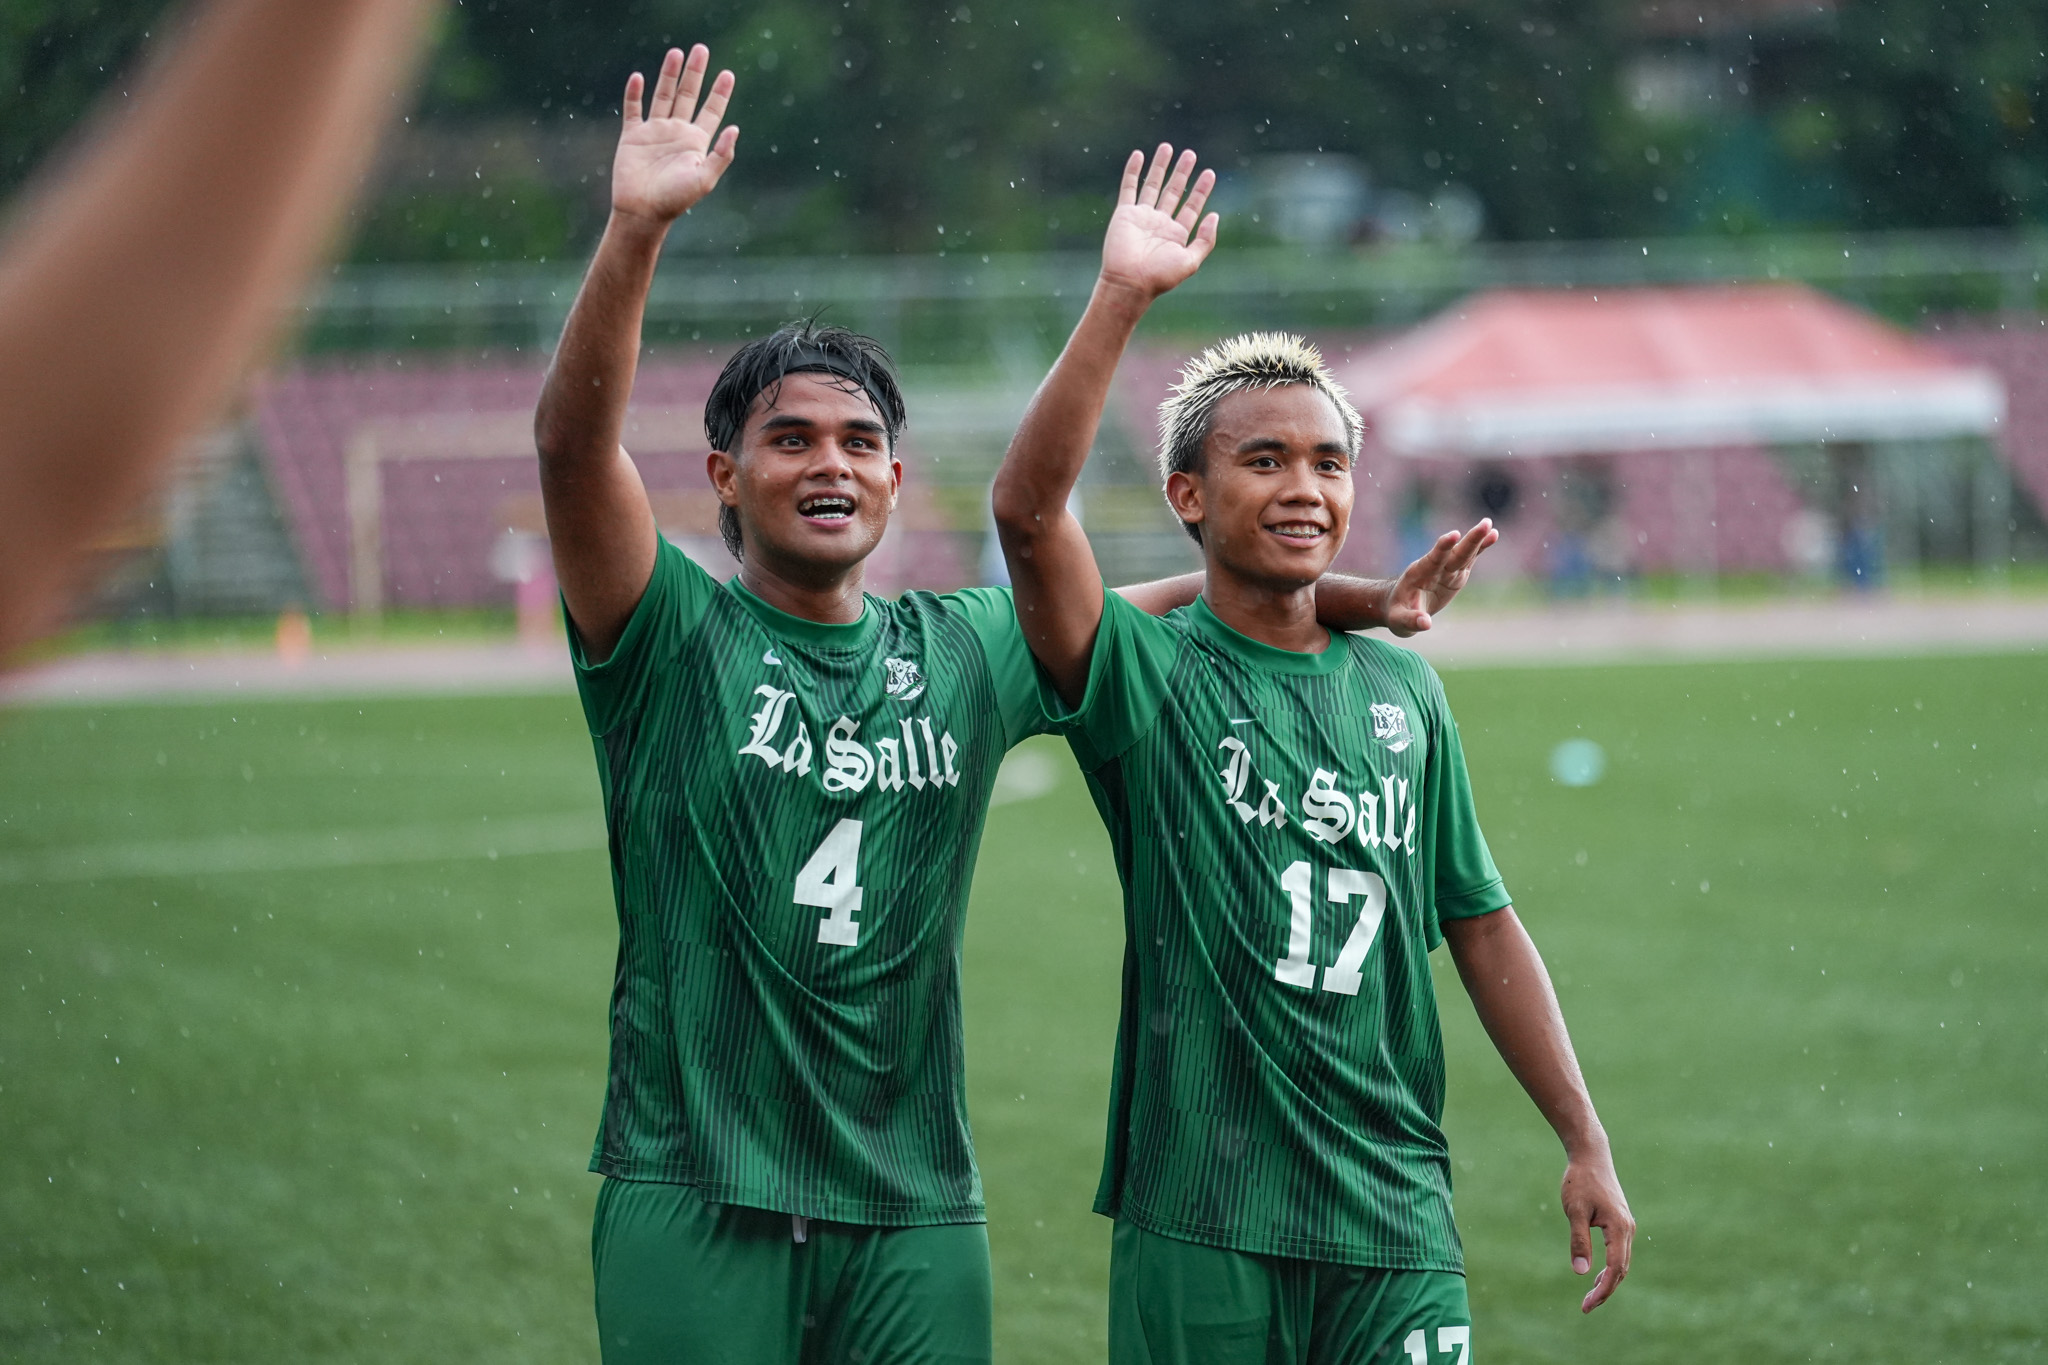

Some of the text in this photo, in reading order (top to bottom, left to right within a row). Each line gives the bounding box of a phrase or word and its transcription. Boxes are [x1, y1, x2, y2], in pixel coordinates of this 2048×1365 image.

[738, 684, 961, 793] La Salle
[1218, 736, 1288, 830] La
[793, 818, 864, 947] 4
[1275, 860, 1387, 996] 17
